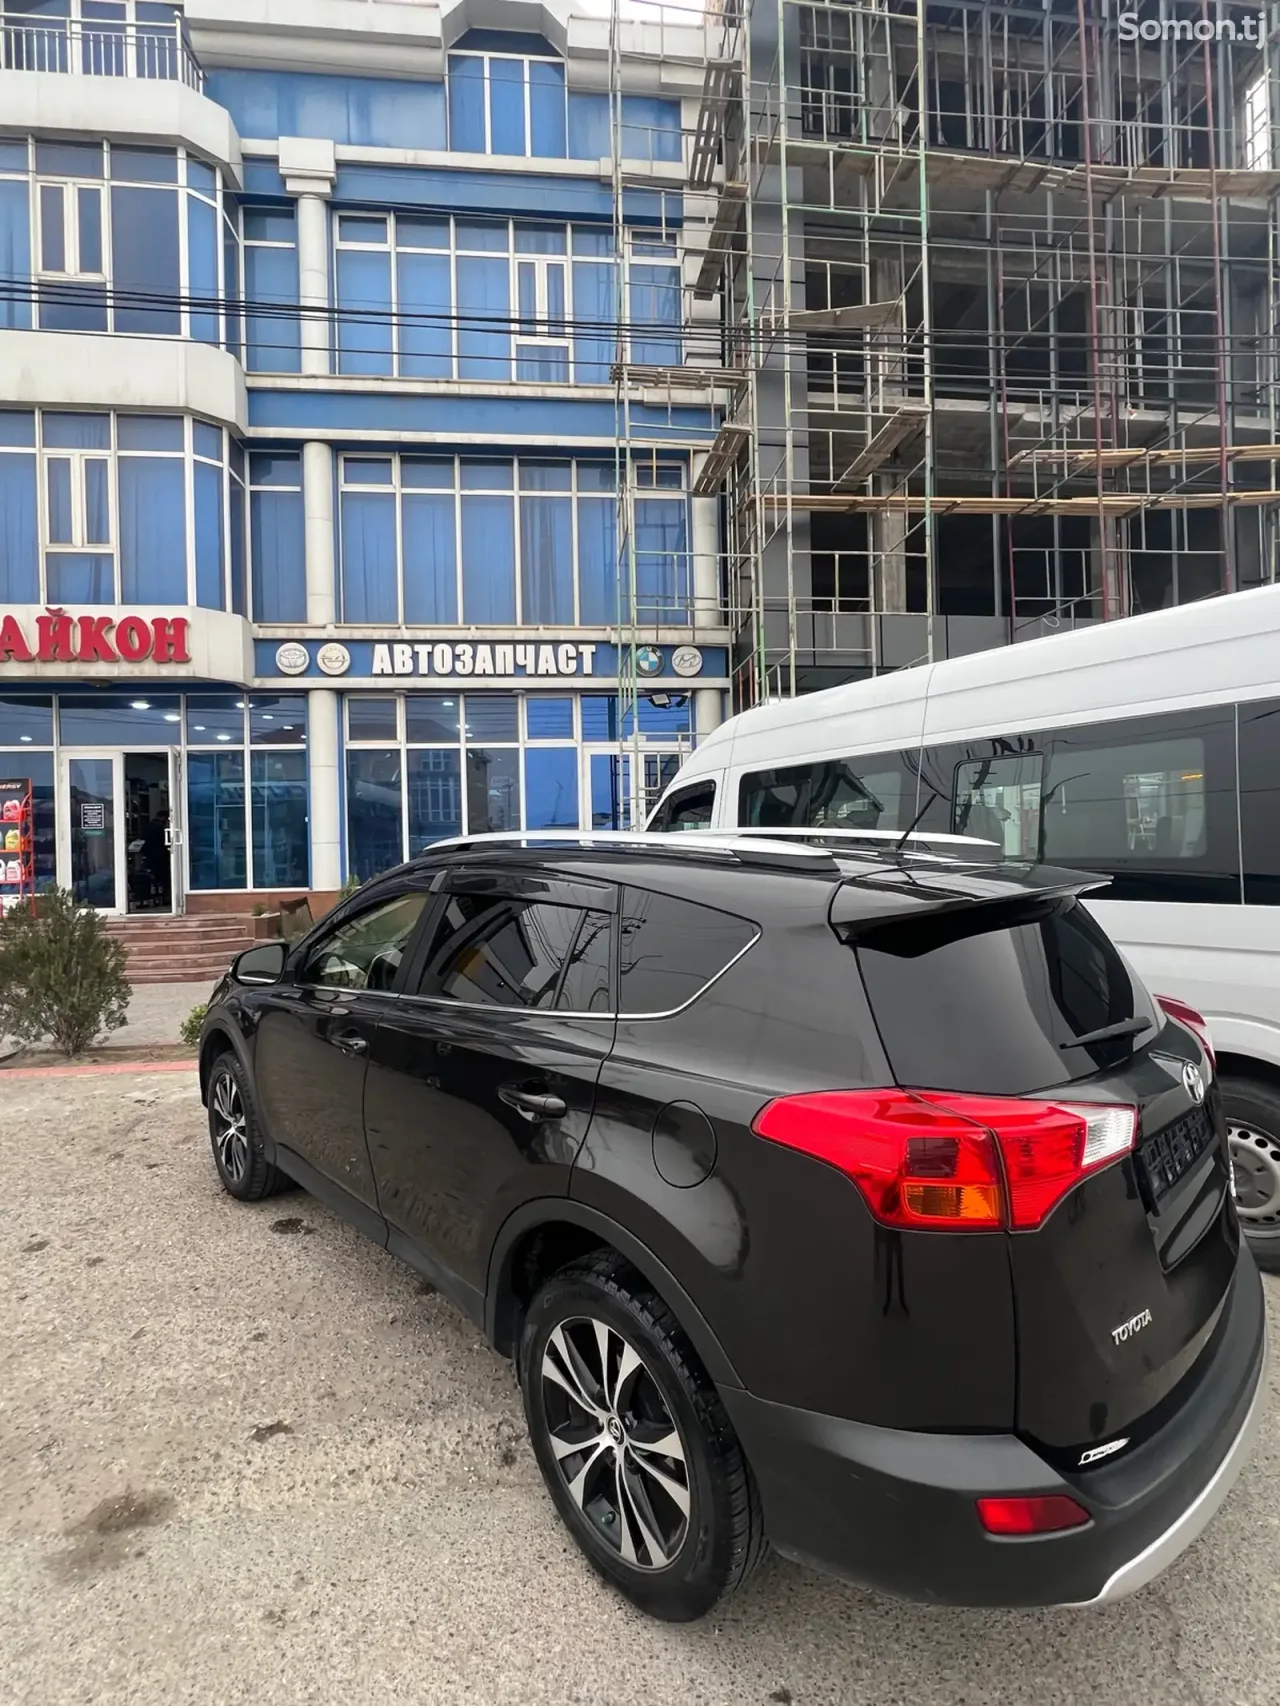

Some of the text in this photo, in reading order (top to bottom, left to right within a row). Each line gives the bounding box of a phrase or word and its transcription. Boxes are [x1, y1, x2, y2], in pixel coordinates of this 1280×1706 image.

[0, 607, 191, 663] АЙКОН
[372, 643, 597, 676] АВТОЗАПЧАСТ
[1111, 1308, 1153, 1346] TOYOTA
